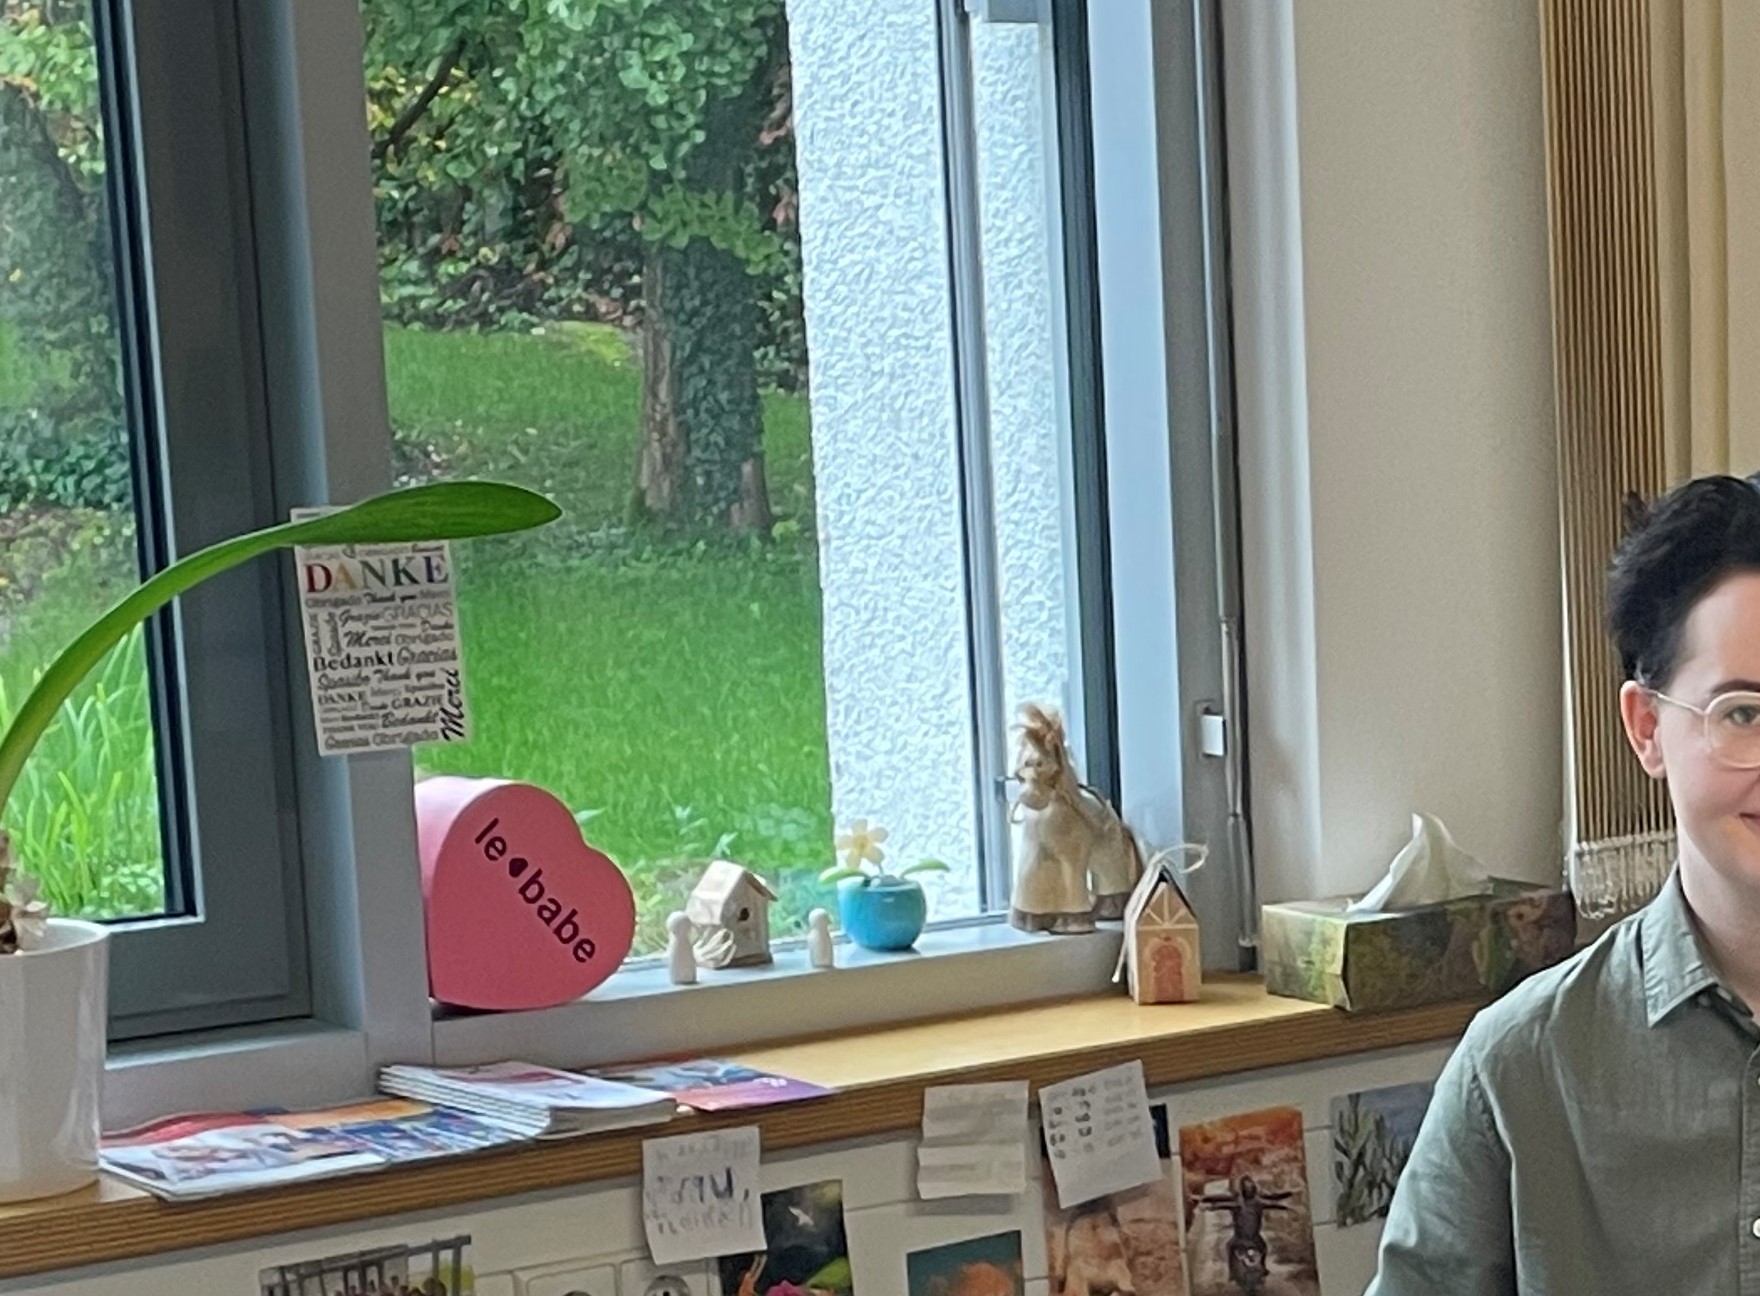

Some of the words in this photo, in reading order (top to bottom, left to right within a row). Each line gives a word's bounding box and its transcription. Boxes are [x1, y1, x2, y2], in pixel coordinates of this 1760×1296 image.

[304, 556, 449, 593] DANKE
[313, 650, 394, 672] Bedankt
[440, 667, 465, 741] Merci
[474, 817, 507, 861] le
[518, 868, 596, 963] babe
